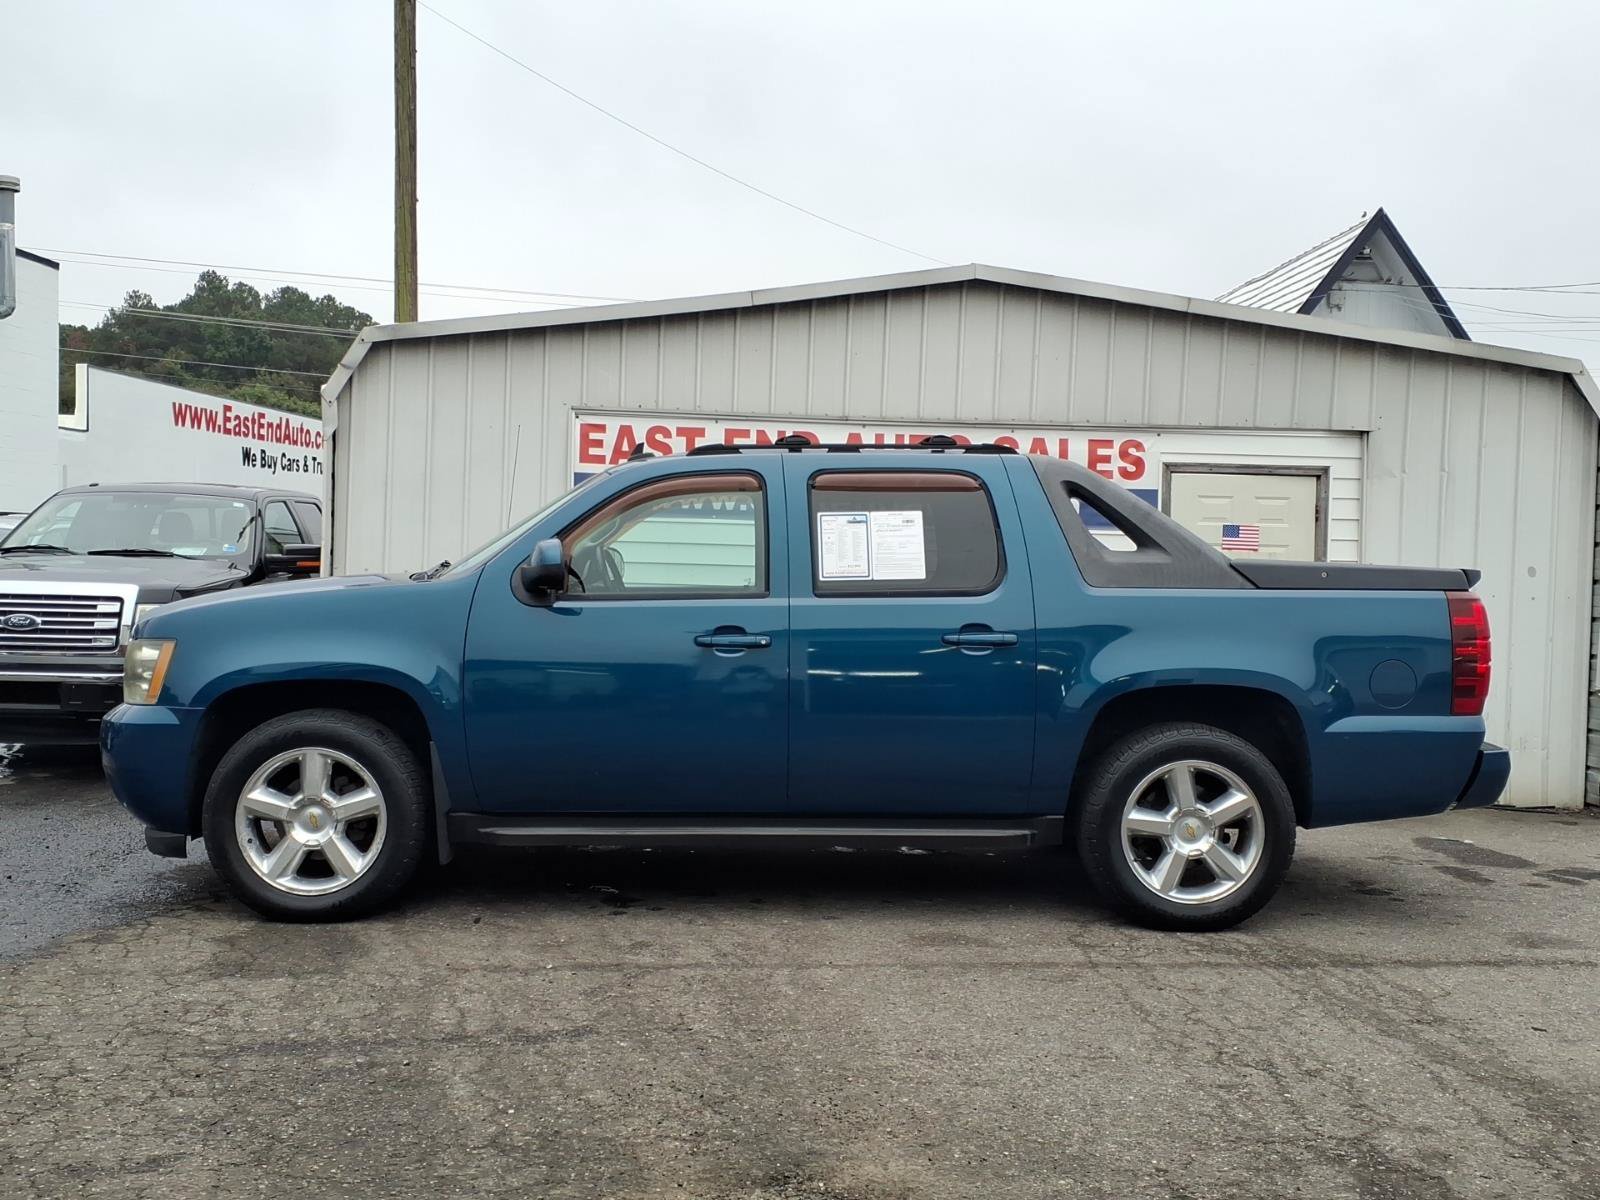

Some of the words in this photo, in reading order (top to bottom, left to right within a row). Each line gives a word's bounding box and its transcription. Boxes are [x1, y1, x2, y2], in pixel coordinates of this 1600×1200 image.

[172, 401, 324, 450] www.EastEndAuto.c
[578, 422, 706, 465] EAST
[242, 446, 257, 468] We
[260, 449, 277, 475] Buy
[280, 452, 300, 473] Cars
[303, 455, 309, 473] &
[8, 615, 31, 626] Ford
